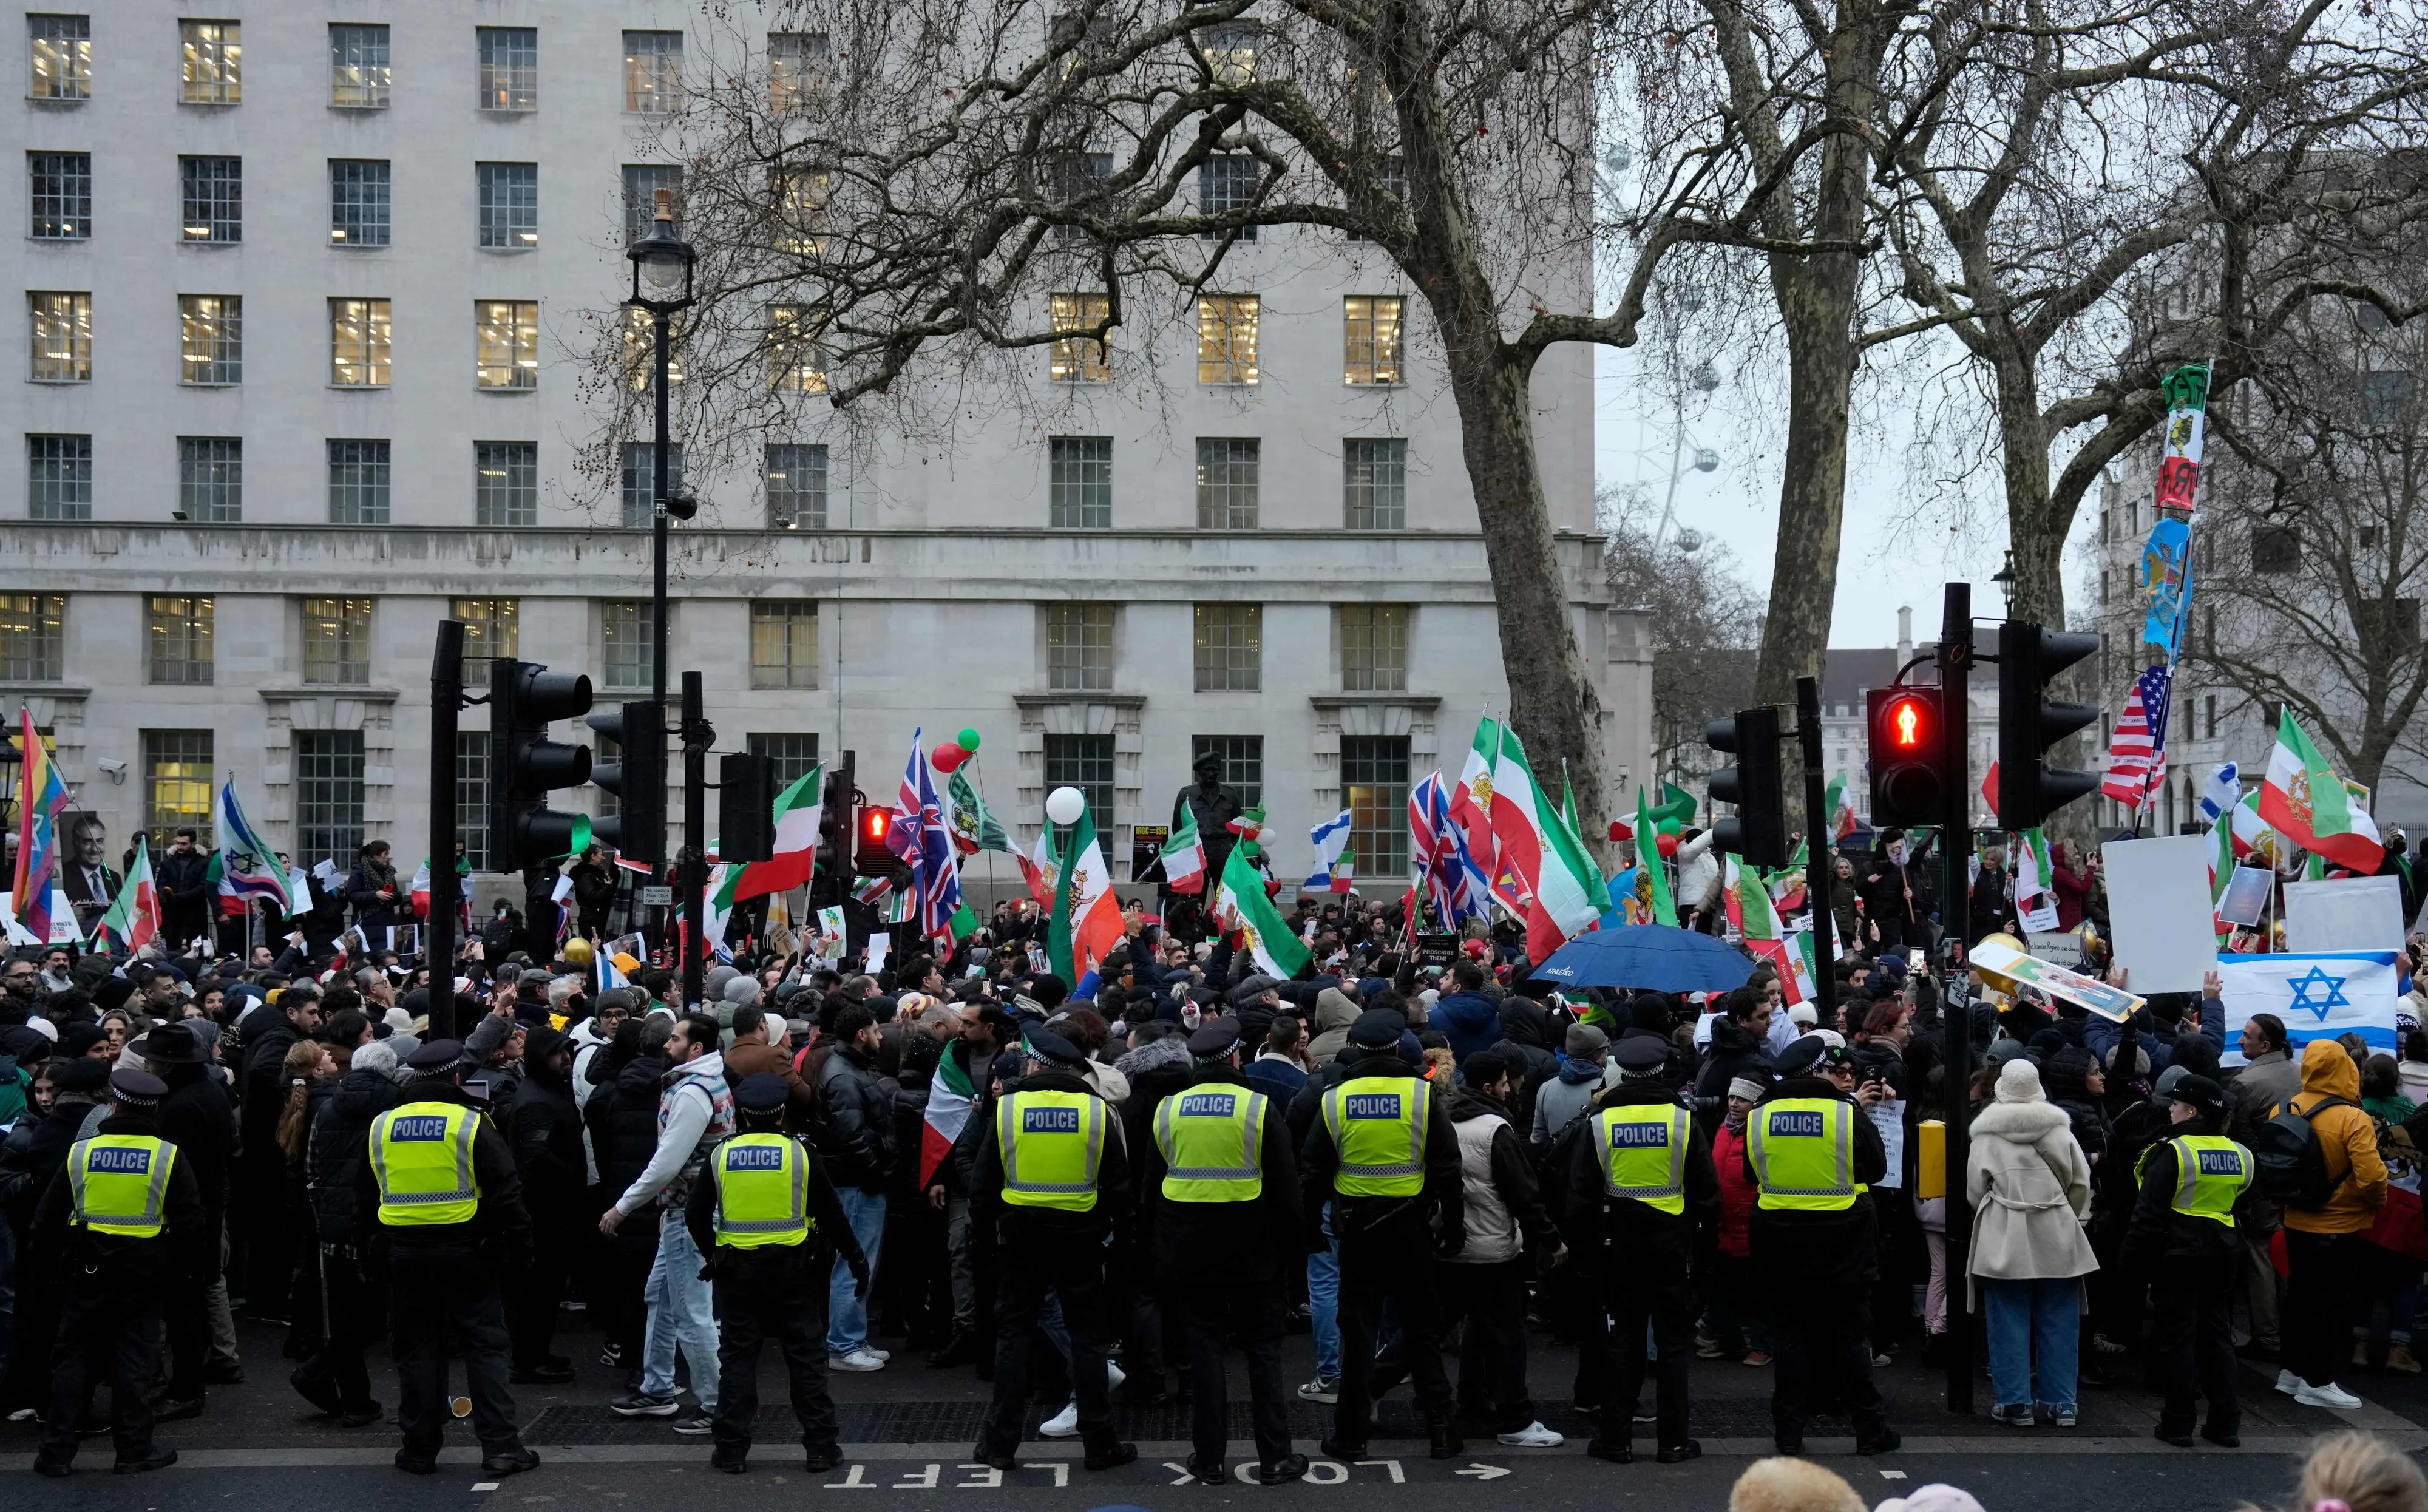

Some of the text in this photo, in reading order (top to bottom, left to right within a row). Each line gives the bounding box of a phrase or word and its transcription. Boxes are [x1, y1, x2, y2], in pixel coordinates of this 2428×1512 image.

[1781, 964, 1791, 985] PAHLAVI
[1182, 1097, 1232, 1112] POLICE
[1349, 1099, 1397, 1114] POLICE
[1026, 1112, 1075, 1127] POLICE
[1772, 1116, 1820, 1131] POLICE
[394, 1120, 442, 1136] POLICE
[1615, 1127, 1664, 1143] POLICE
[92, 1152, 146, 1168] POLICE
[730, 1150, 778, 1165] POLICE
[2202, 1154, 2239, 1170] POLICE
[823, 1463, 1070, 1488] LEFT
